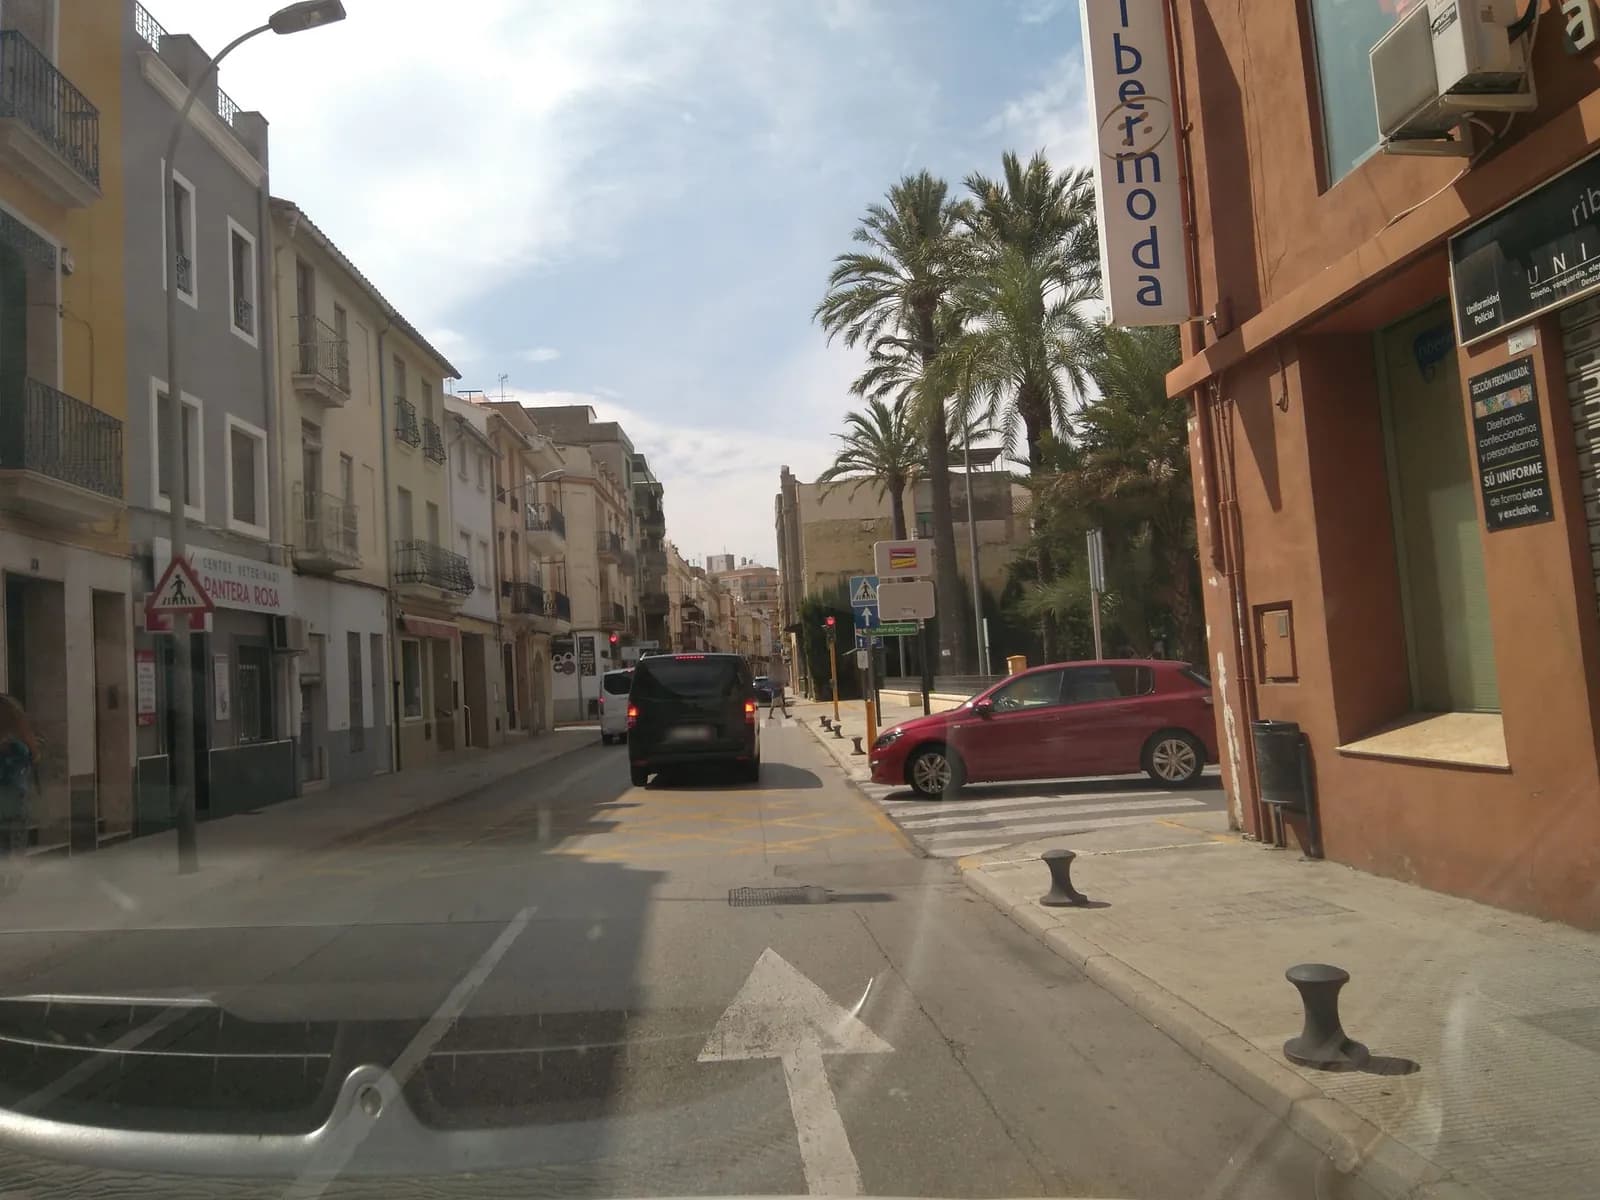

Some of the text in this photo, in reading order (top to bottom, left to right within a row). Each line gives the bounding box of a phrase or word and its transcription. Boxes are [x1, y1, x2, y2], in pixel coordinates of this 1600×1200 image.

[1466, 291, 1500, 316] Uniformidad
[1474, 307, 1495, 325] Policial
[1472, 377, 1492, 395] SECCIÓN
[1479, 423, 1537, 448] confeccionamos
[1486, 438, 1540, 462] personalizamos
[1496, 462, 1543, 484] UNIFORME
[1490, 487, 1543, 507] de forma única
[1497, 511, 1503, 521] y
[203, 575, 280, 608] PANTERA ROSA
